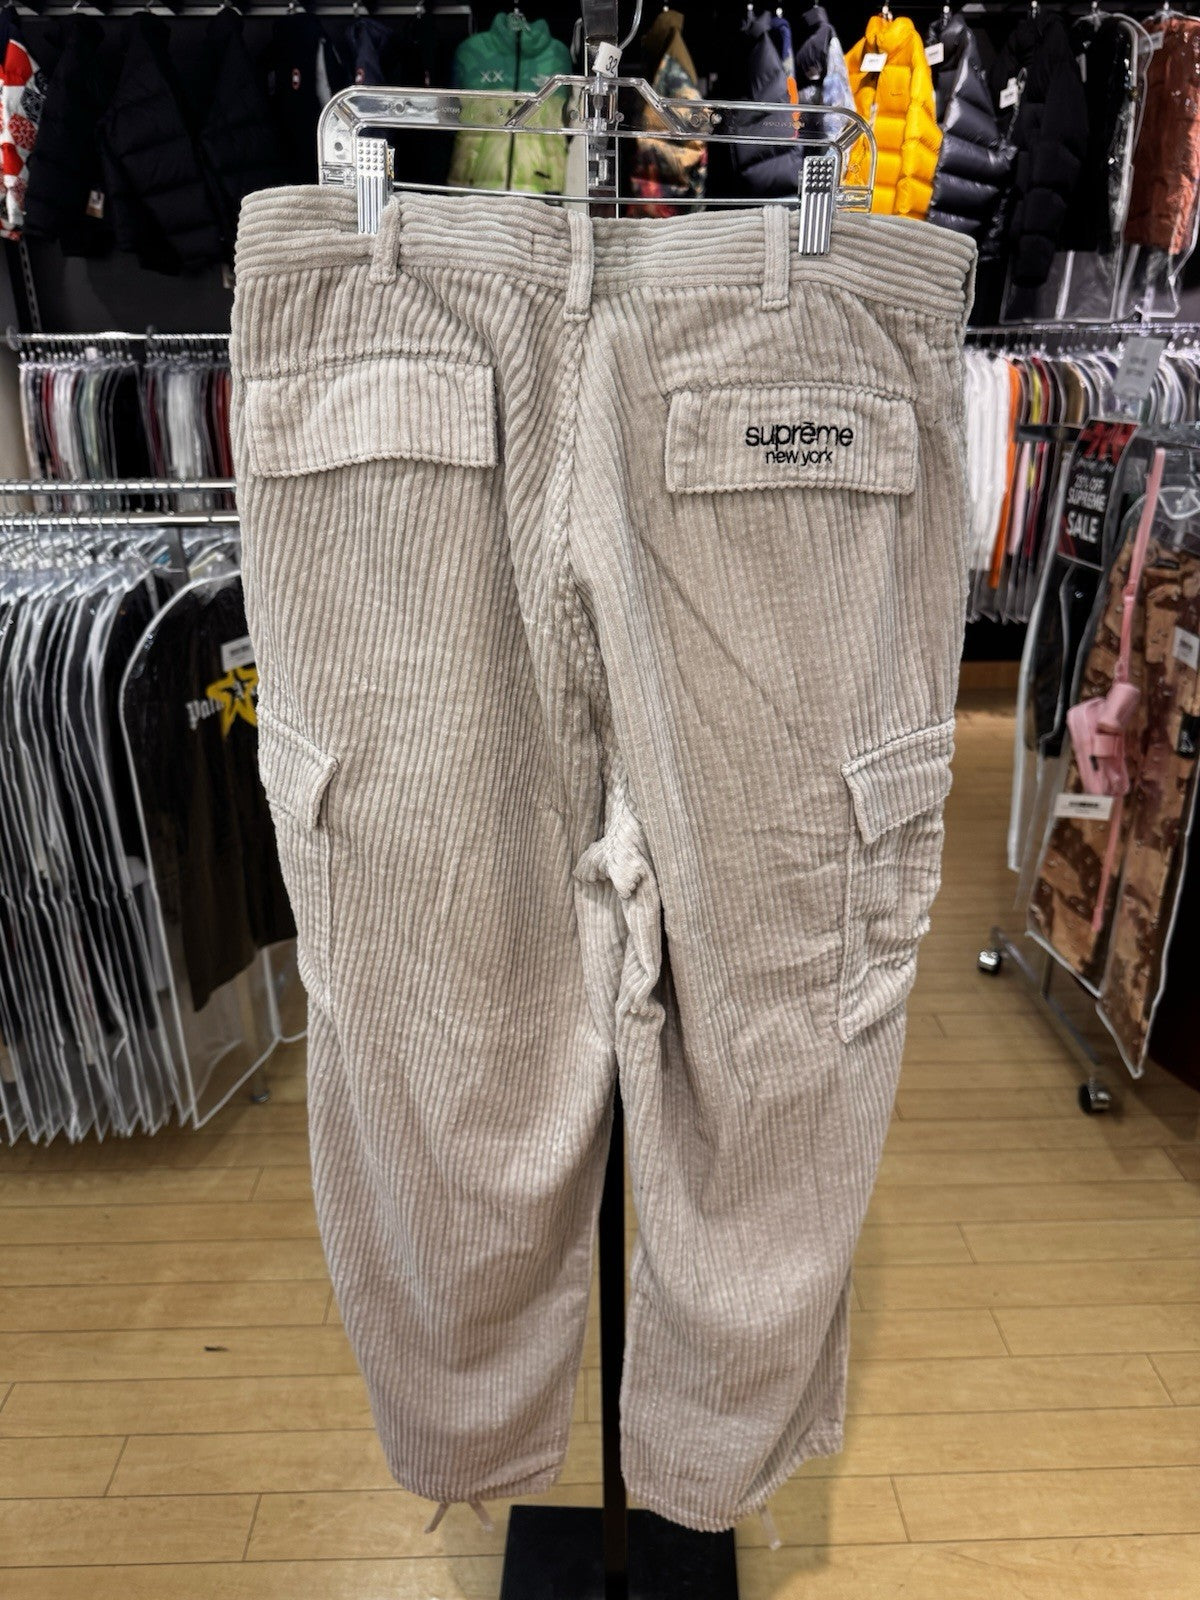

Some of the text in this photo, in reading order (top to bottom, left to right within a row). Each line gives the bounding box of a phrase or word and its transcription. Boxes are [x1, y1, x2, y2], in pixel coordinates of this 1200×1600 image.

[605, 55, 618, 75] 32
[766, 447, 833, 466] new york
[1067, 486, 1107, 513] SUPREME
[1066, 510, 1099, 544] SALE
